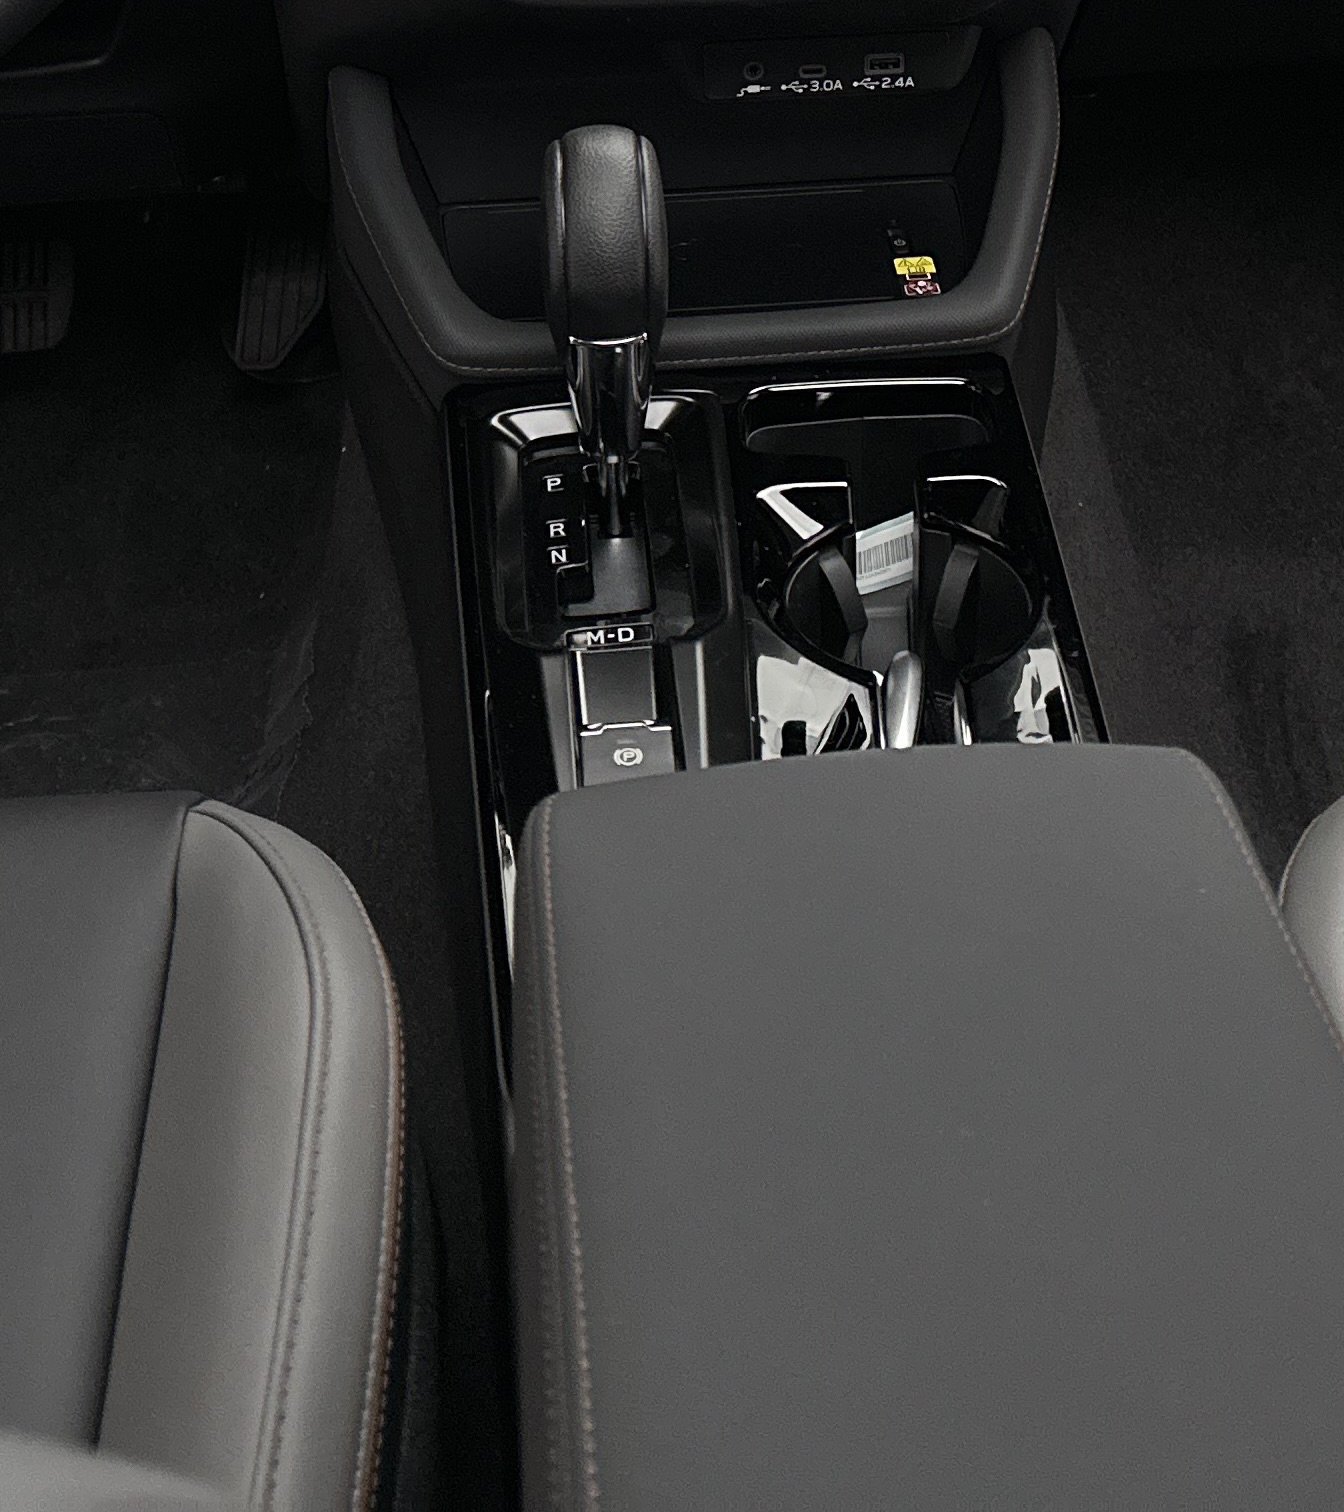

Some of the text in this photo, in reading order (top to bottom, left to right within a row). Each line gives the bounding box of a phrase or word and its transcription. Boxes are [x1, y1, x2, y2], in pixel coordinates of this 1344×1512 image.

[810, 76, 915, 92] 3.0A 2.4A
[547, 477, 561, 491] P
[550, 523, 566, 537] R
[552, 550, 567, 563] N
[587, 627, 635, 645] M-D
